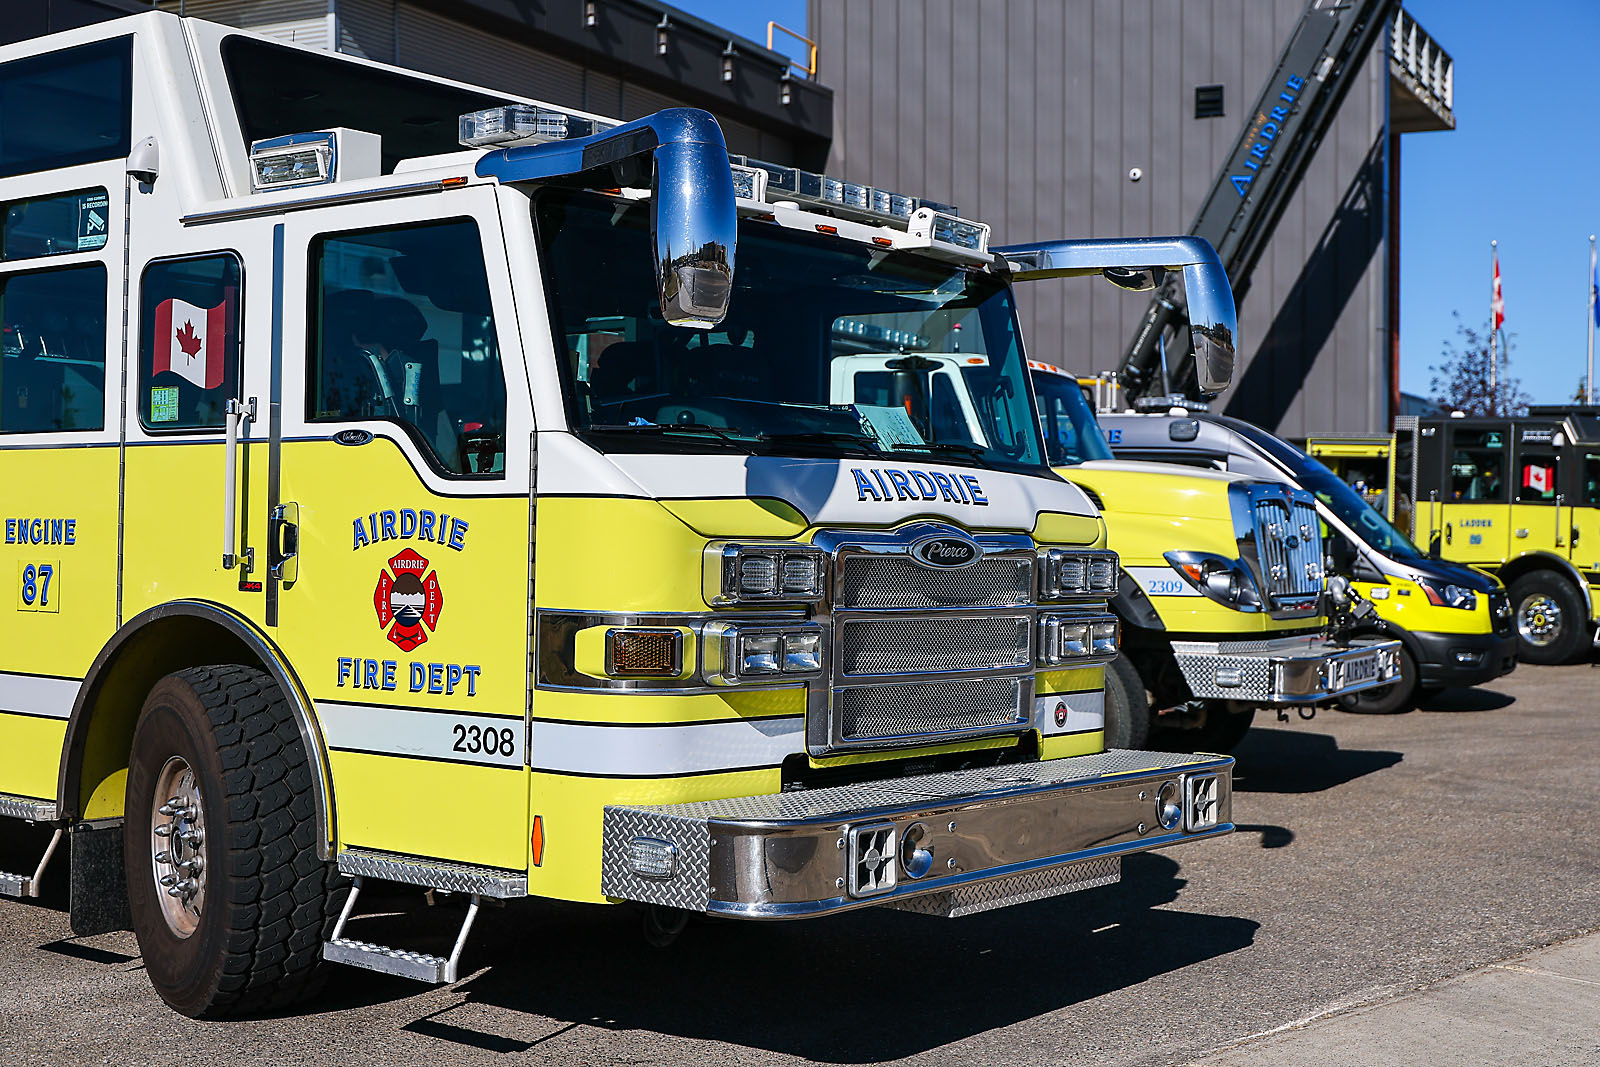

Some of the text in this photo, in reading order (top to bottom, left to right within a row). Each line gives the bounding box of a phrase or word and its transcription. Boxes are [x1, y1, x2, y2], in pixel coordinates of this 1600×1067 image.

[1230, 73, 1304, 197] AIRDRIE
[850, 468, 990, 506] AIRDRIE
[5, 518, 77, 546] ENGINE
[352, 508, 470, 552] AIRDRIE
[392, 558, 425, 570] AIRDRIE
[926, 541, 969, 560] Pierce
[22, 563, 54, 606] 87
[1148, 579, 1183, 594] 2309
[337, 657, 482, 697] FIRE DEPT
[452, 724, 515, 757] 2308
